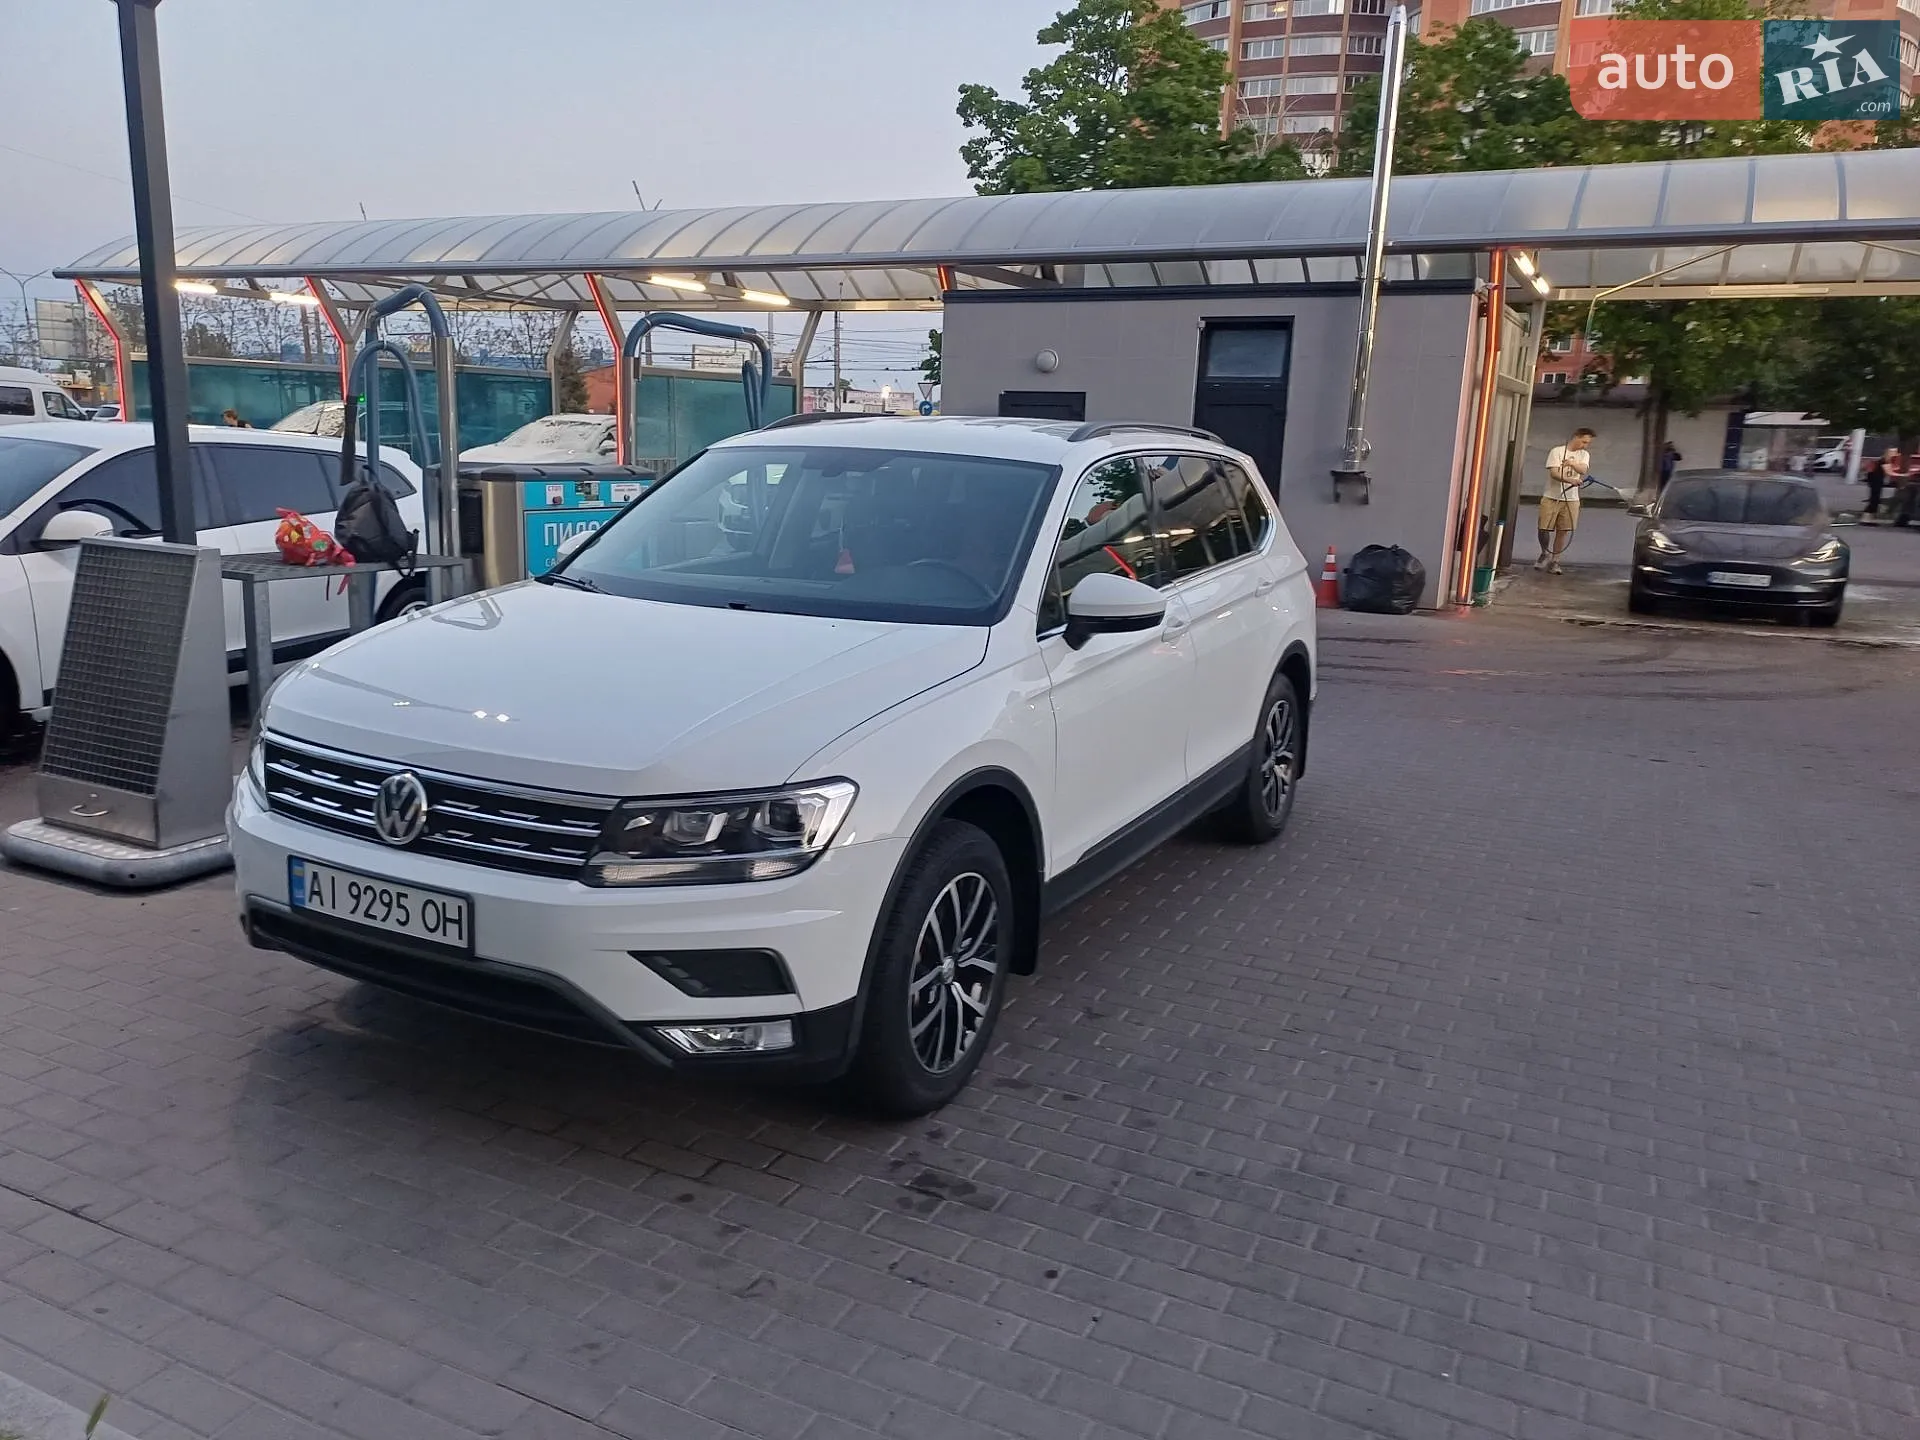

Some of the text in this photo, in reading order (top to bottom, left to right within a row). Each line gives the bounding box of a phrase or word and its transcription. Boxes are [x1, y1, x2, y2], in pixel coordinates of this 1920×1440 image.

[308, 871, 463, 940] AI 9295 OH
